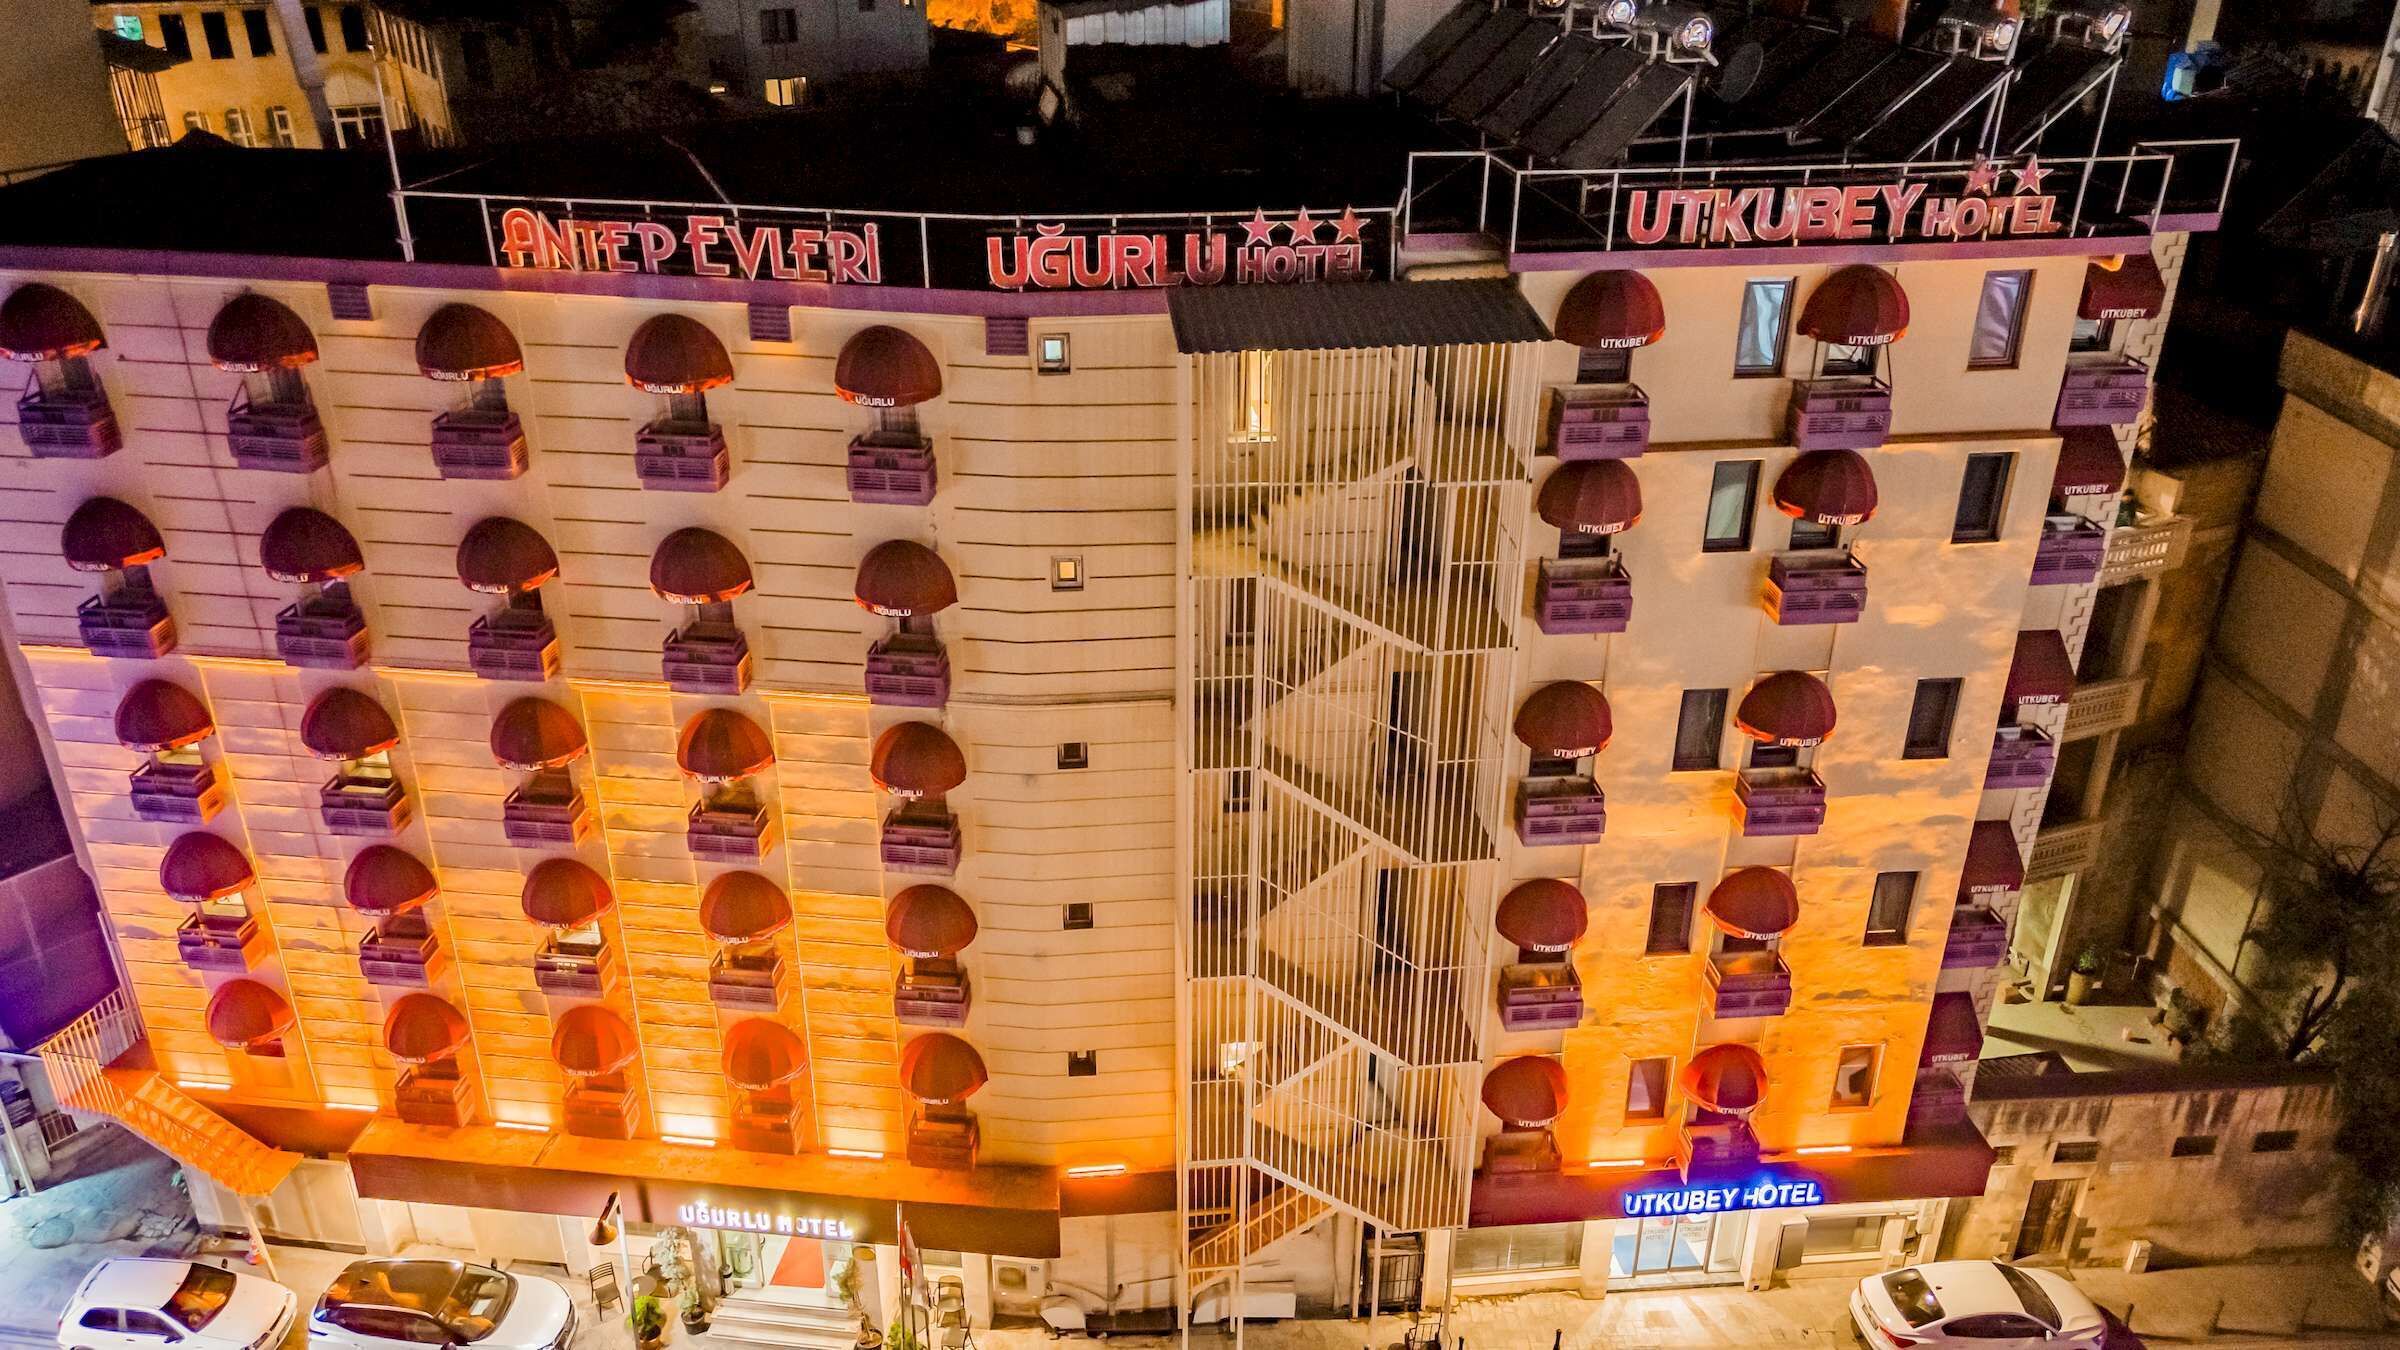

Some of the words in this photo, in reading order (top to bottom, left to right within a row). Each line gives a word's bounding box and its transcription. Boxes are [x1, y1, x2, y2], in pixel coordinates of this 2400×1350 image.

[1626, 183, 1928, 245] UTKUBEY
[1921, 196, 2062, 238] HOTEL
[501, 208, 677, 273] ANTEP
[683, 215, 881, 284] EVLERİ
[986, 222, 1227, 288] UĞURLU
[1236, 244, 1373, 285] HOTEL
[2101, 307, 2147, 320] UTKUBEY
[1601, 335, 1648, 349] UTKUBEY
[1848, 333, 1895, 346] UTKUBEY
[644, 382, 684, 394] UĞURLU
[855, 394, 896, 407] UĞURLU
[2064, 484, 2109, 496] UTKUBEY
[1818, 513, 1864, 526] UTKUBEY
[1577, 521, 1624, 535] UTKUBEY
[2018, 694, 2061, 705] UTKUBEY
[1553, 746, 1597, 759] UTKUBEY
[1971, 884, 2011, 894] UTKUBEY
[1931, 1053, 1970, 1063] UTKUBEY
[1624, 1187, 1740, 1215] UTKUBEY
[1743, 1183, 1822, 1207] HOTEL
[680, 1200, 771, 1232] UĞURLU
[776, 1213, 854, 1239] HOTEL
